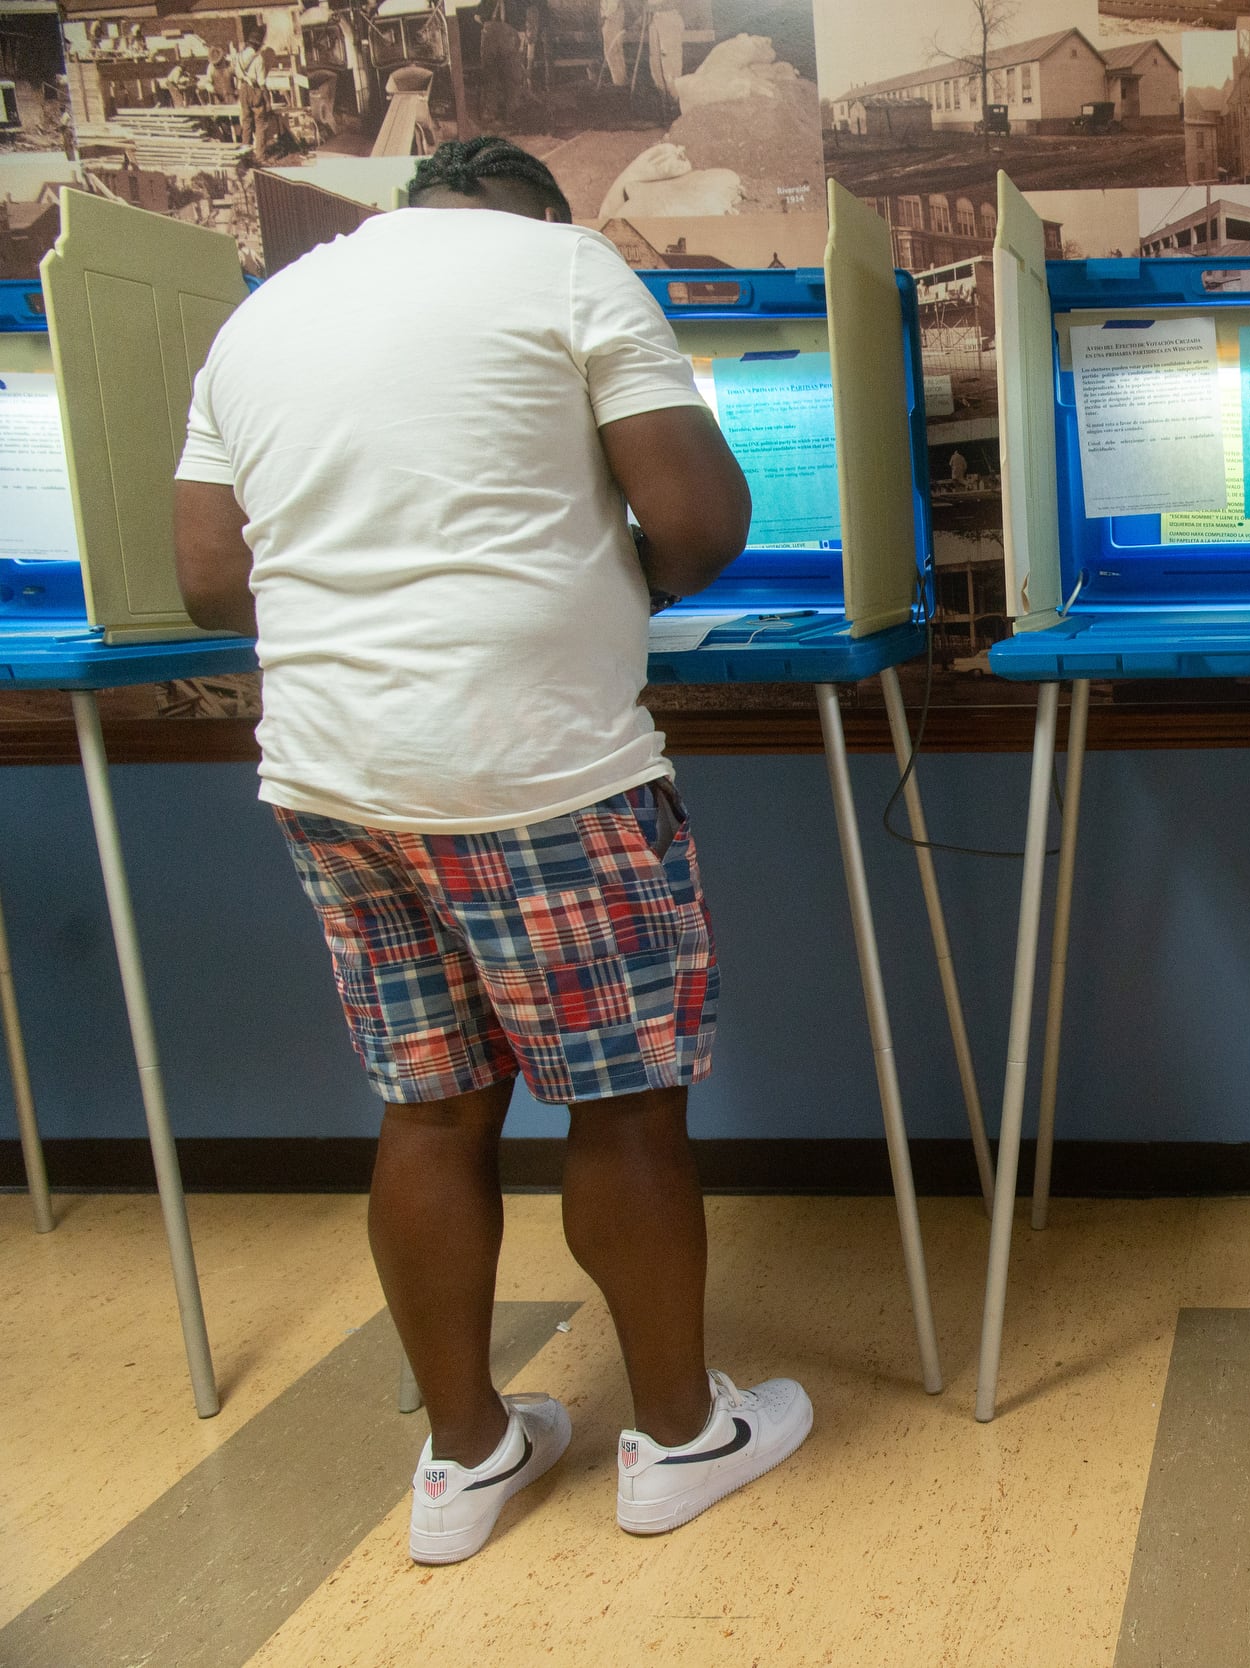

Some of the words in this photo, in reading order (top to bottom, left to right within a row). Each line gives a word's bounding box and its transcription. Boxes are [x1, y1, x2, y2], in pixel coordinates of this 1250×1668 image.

[776, 185, 810, 196] Riverside
[786, 194, 805, 204] 1914
[622, 1442, 637, 1451] USA
[426, 1471, 446, 1483] USA
